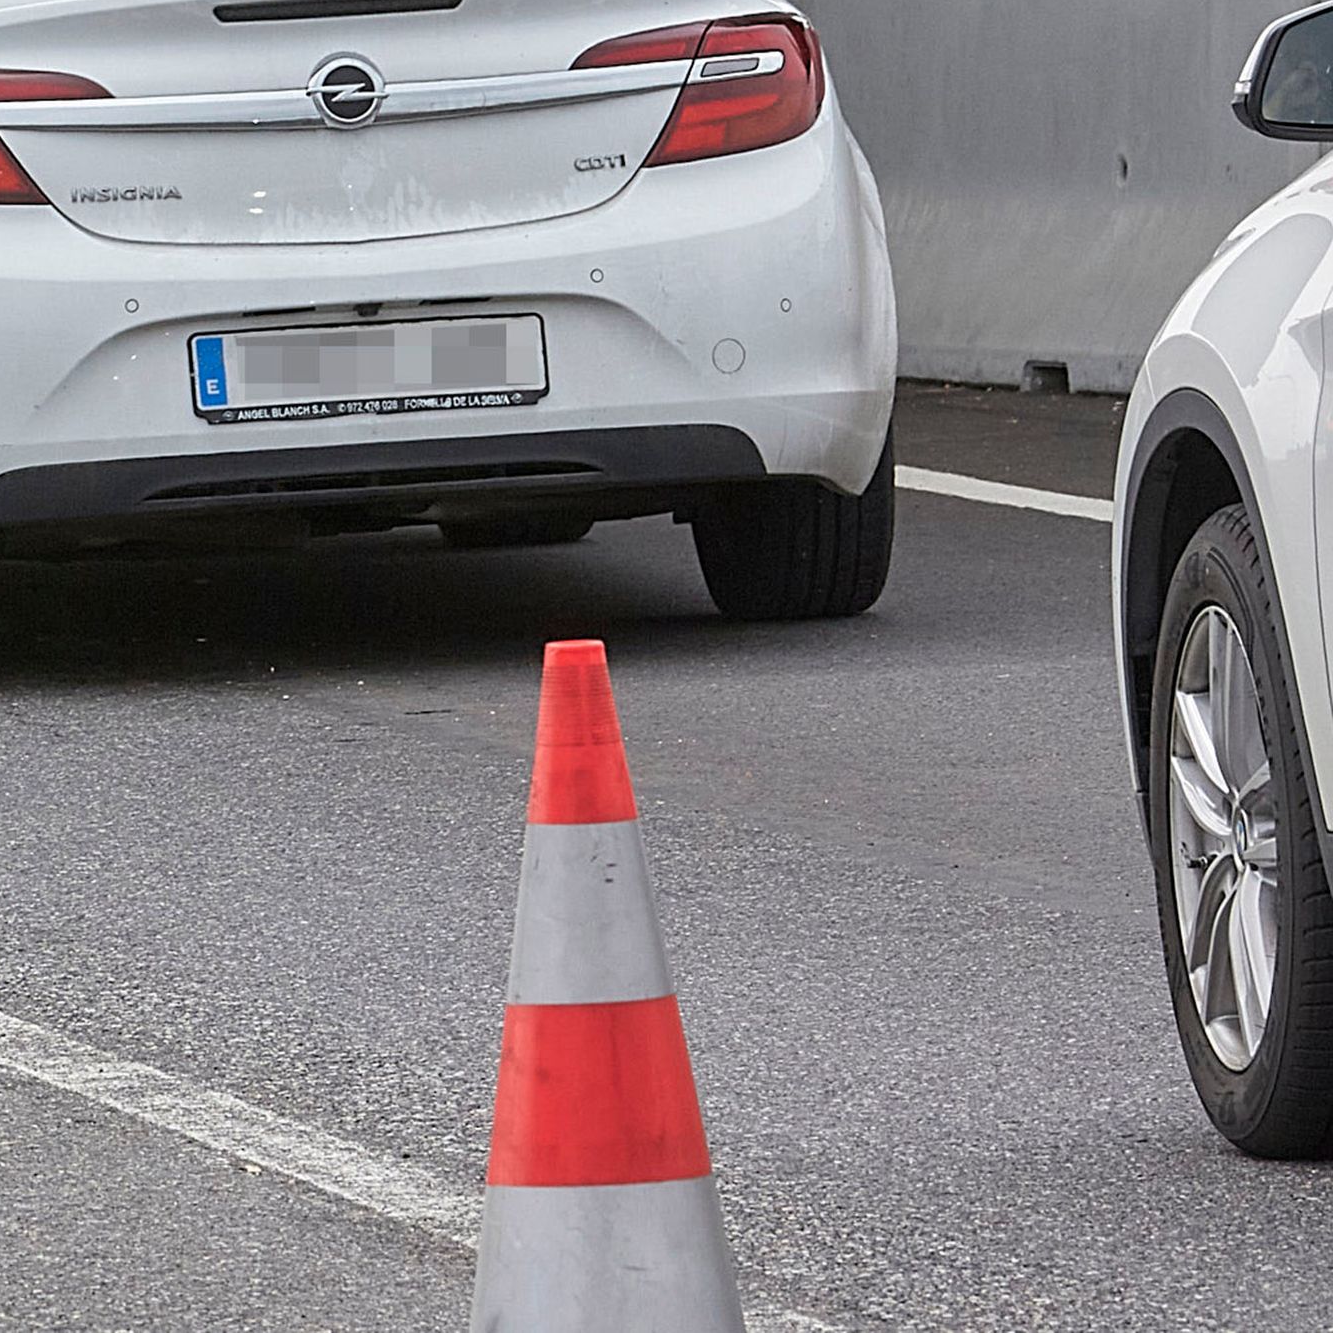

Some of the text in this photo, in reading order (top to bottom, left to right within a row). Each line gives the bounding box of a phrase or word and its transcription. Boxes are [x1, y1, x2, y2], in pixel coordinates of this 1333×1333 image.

[573, 154, 626, 172] CDTI
[70, 184, 183, 204] INSIGNIA
[206, 378, 220, 395] E
[237, 408, 270, 421] ANGEL
[271, 405, 310, 419] BLANCH
